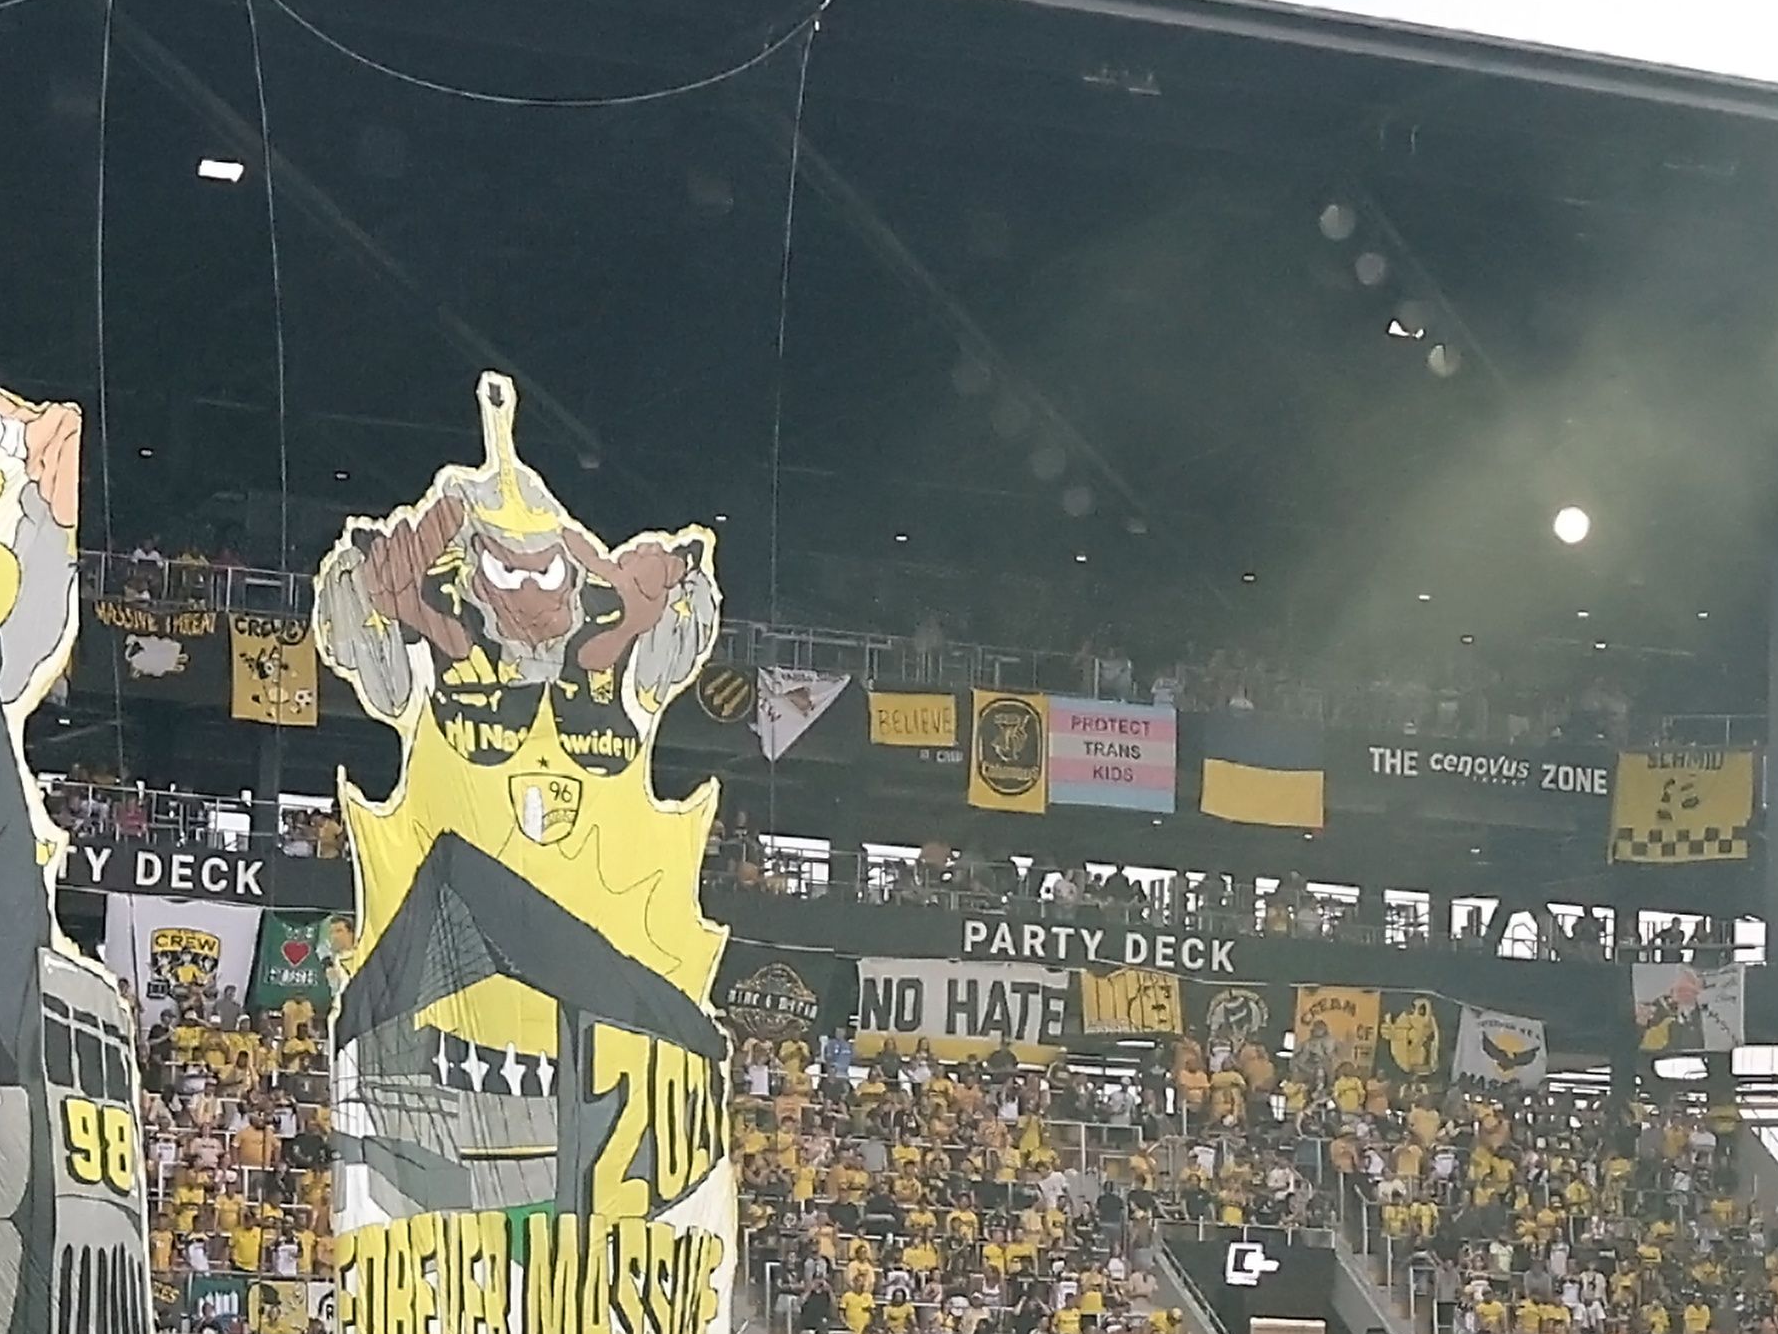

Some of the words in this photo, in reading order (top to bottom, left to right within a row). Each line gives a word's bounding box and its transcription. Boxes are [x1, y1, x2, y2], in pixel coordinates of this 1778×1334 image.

[877, 707, 955, 735] BELIEVE
[1071, 715, 1151, 737] PROTECT
[1083, 740, 1142, 761] TRANS
[1092, 765, 1134, 783] KIDS
[1369, 746, 1419, 777] THE
[1429, 751, 1530, 780] cenovus
[1539, 764, 1608, 796] ZONE
[548, 780, 573, 803] 96
[135, 850, 264, 896] DECK
[155, 932, 217, 952] CREW
[962, 919, 1109, 962] PARTY
[1125, 931, 1237, 973] DECK
[859, 976, 922, 1033] NO
[945, 977, 1064, 1044] HATE
[59, 1097, 137, 1198] 98
